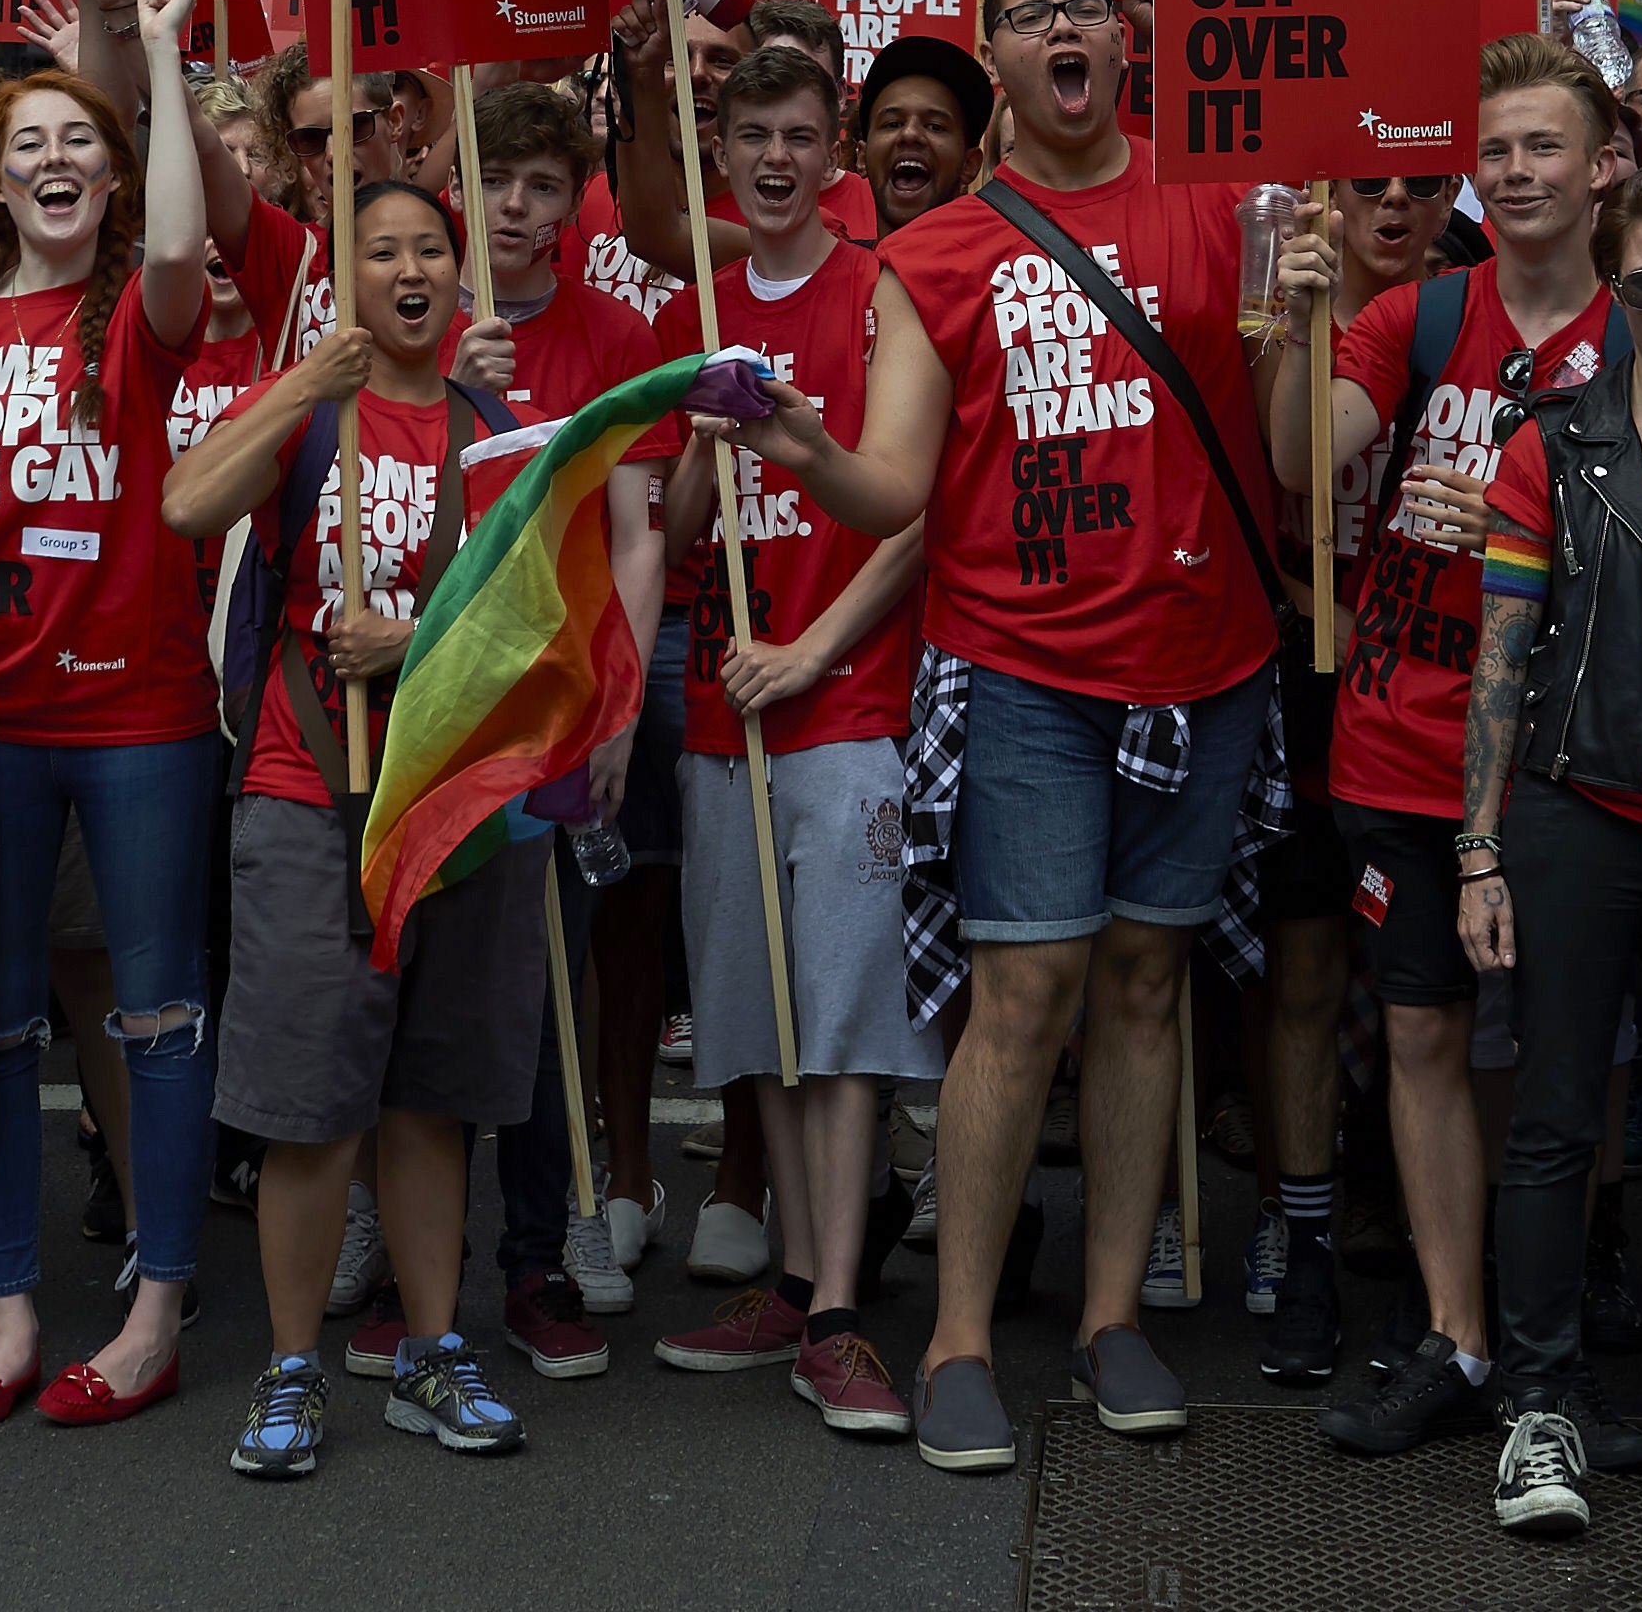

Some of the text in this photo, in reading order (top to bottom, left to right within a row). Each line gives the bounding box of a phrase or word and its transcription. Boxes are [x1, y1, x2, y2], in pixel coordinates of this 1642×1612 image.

[514, 5, 585, 27] Stonewall
[1186, 15, 1348, 81] OVER
[1187, 89, 1262, 154] IT!
[1377, 120, 1452, 140] Stonewall
[1005, 339, 1093, 395] ARE
[10, 444, 122, 502] GAY.
[1012, 439, 1089, 490] GET
[1012, 484, 1134, 538] OVER
[39, 535, 89, 552] Group 5
[1015, 539, 1068, 585] IT!
[72, 656, 125, 672] Stonewall
[858, 862, 899, 884] Team
